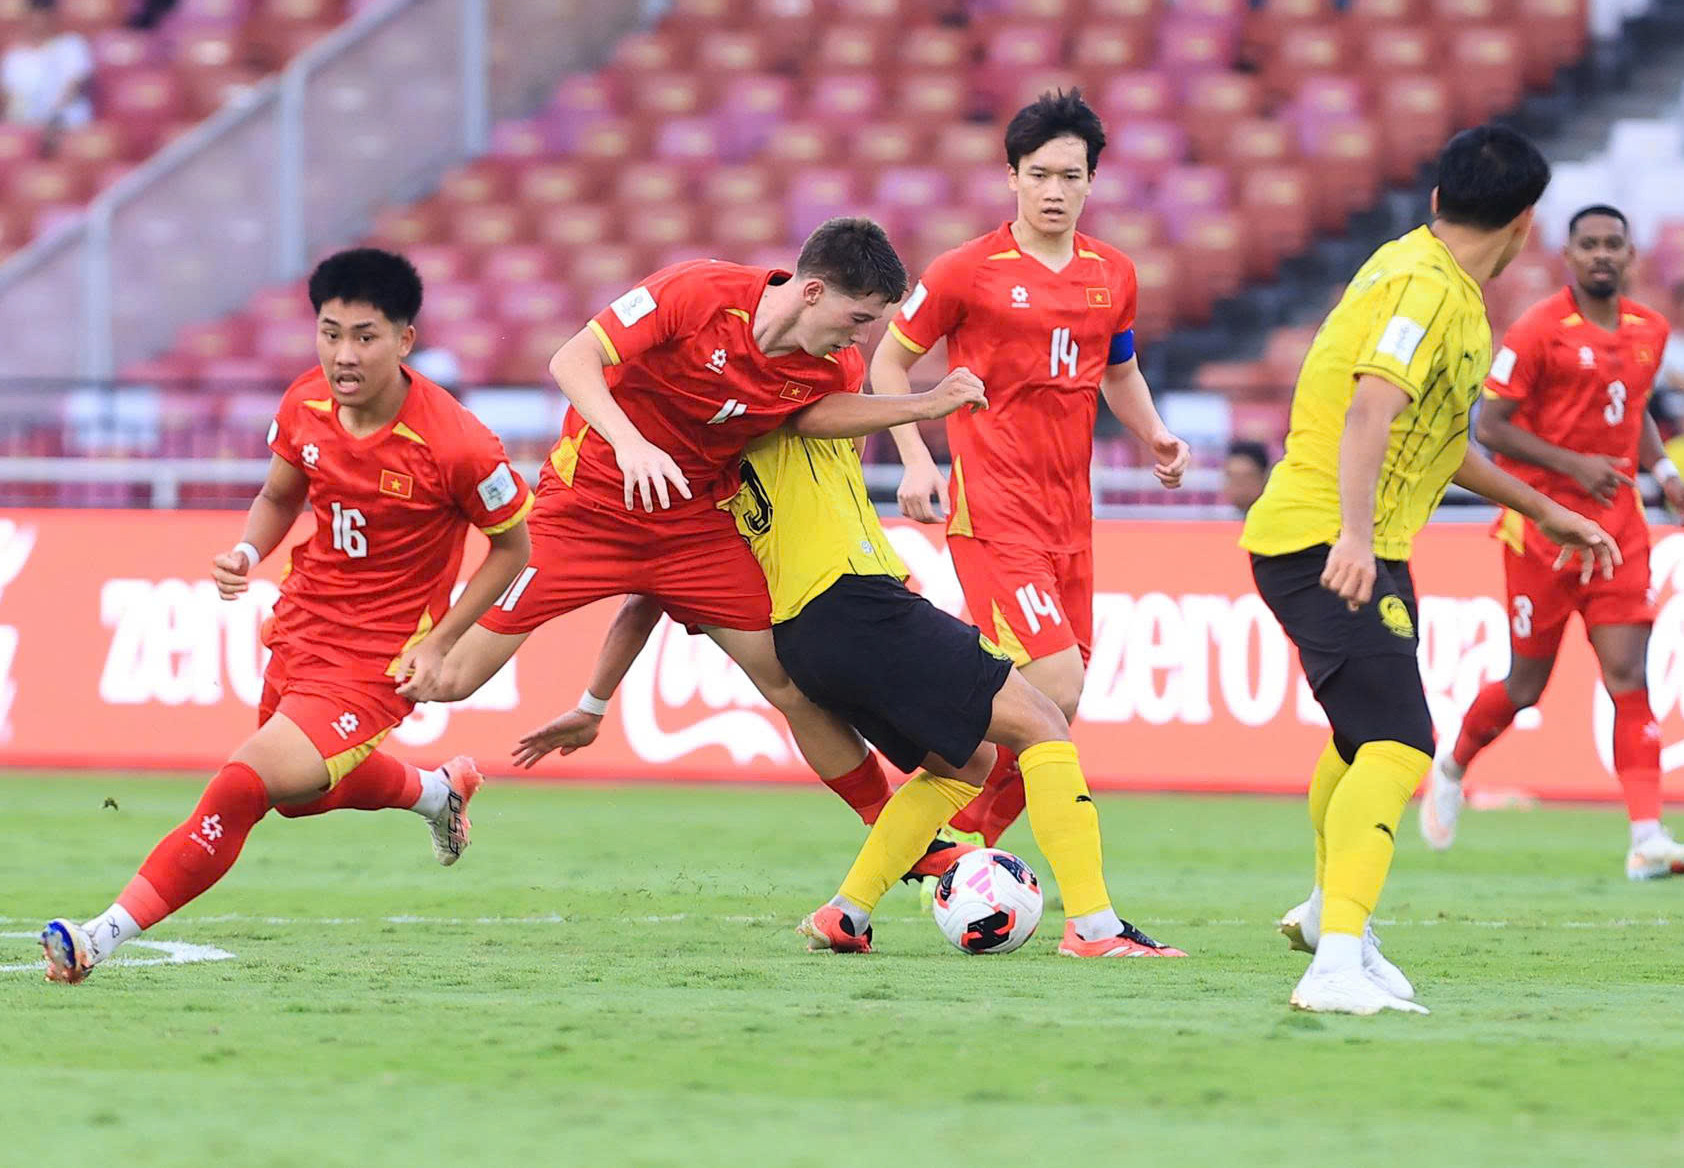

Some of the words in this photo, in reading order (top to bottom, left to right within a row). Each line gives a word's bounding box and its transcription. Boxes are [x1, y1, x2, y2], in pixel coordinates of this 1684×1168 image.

[1050, 327, 1079, 378] 14
[1604, 380, 1627, 426] 3
[331, 502, 368, 557] 16
[1016, 582, 1062, 635] 14
[1513, 595, 1534, 638] 3
[1078, 592, 1289, 726] zero
